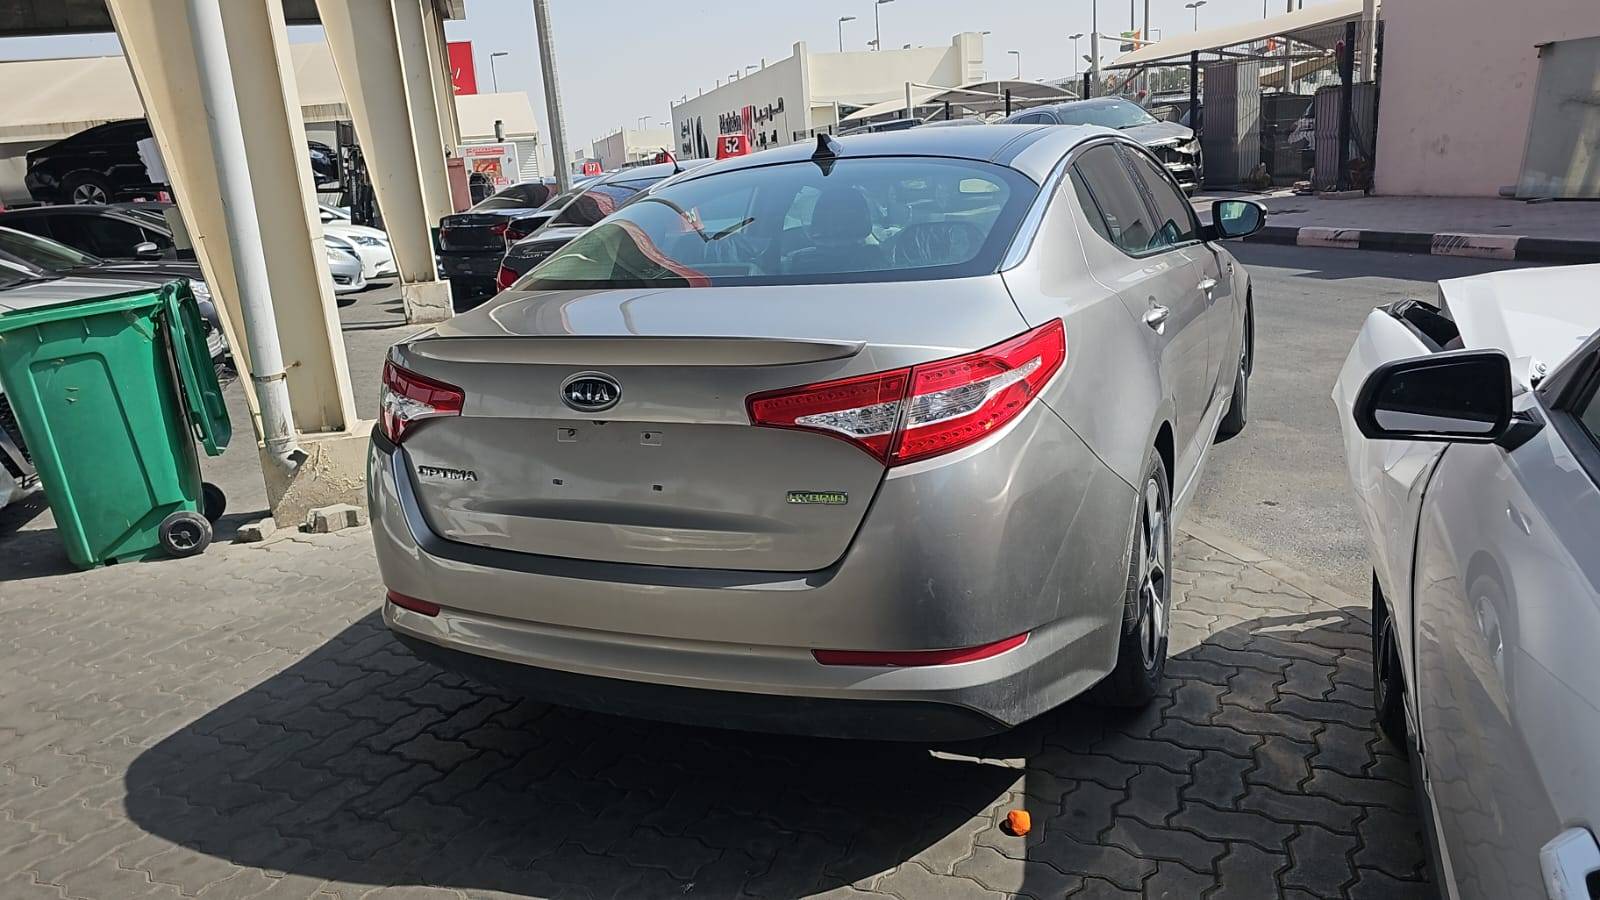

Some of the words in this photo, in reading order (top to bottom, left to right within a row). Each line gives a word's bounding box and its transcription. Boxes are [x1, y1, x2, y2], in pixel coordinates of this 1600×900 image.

[725, 137, 739, 153] 52
[571, 383, 610, 401] KIA
[418, 465, 478, 481] OPTIMA
[787, 491, 848, 504] HYBRID
